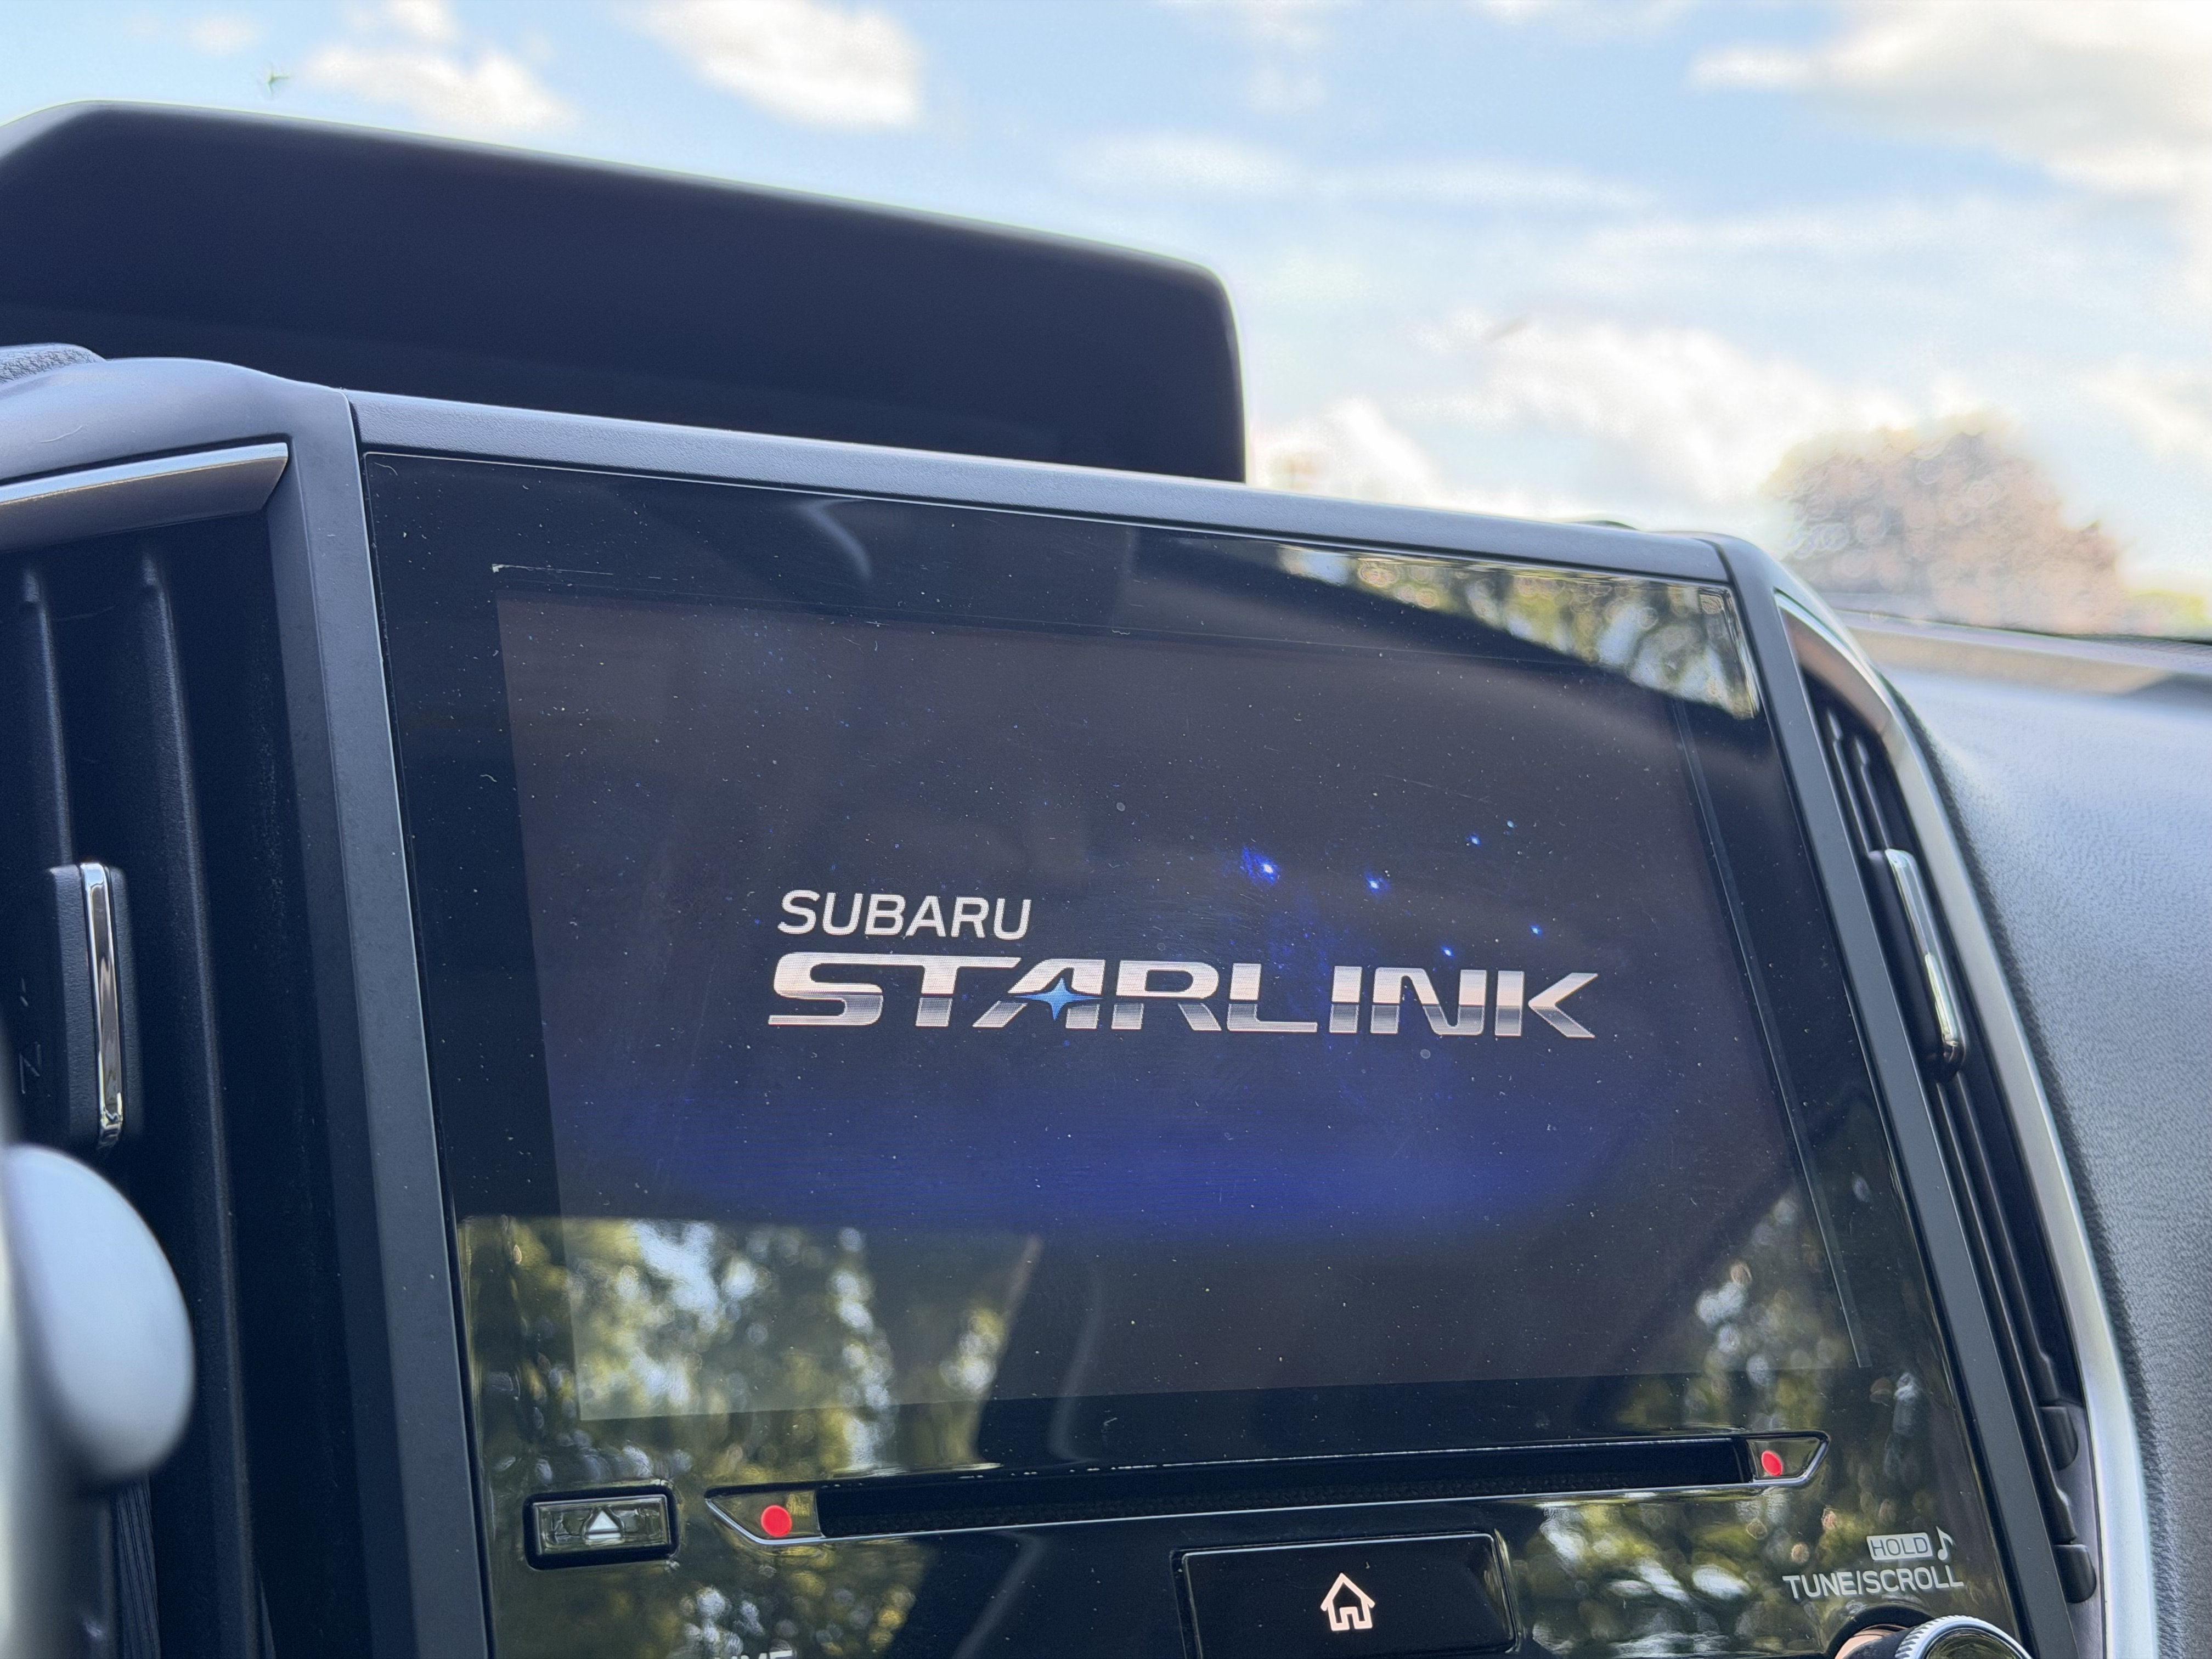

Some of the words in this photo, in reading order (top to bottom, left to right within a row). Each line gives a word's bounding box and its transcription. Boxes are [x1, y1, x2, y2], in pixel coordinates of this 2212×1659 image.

[777, 889, 1031, 940] SUBARU
[768, 952, 1599, 1039] STARLINK
[1870, 1537, 1929, 1557] HOLD
[1781, 1565, 1964, 1599] TUNE/SCROLL
